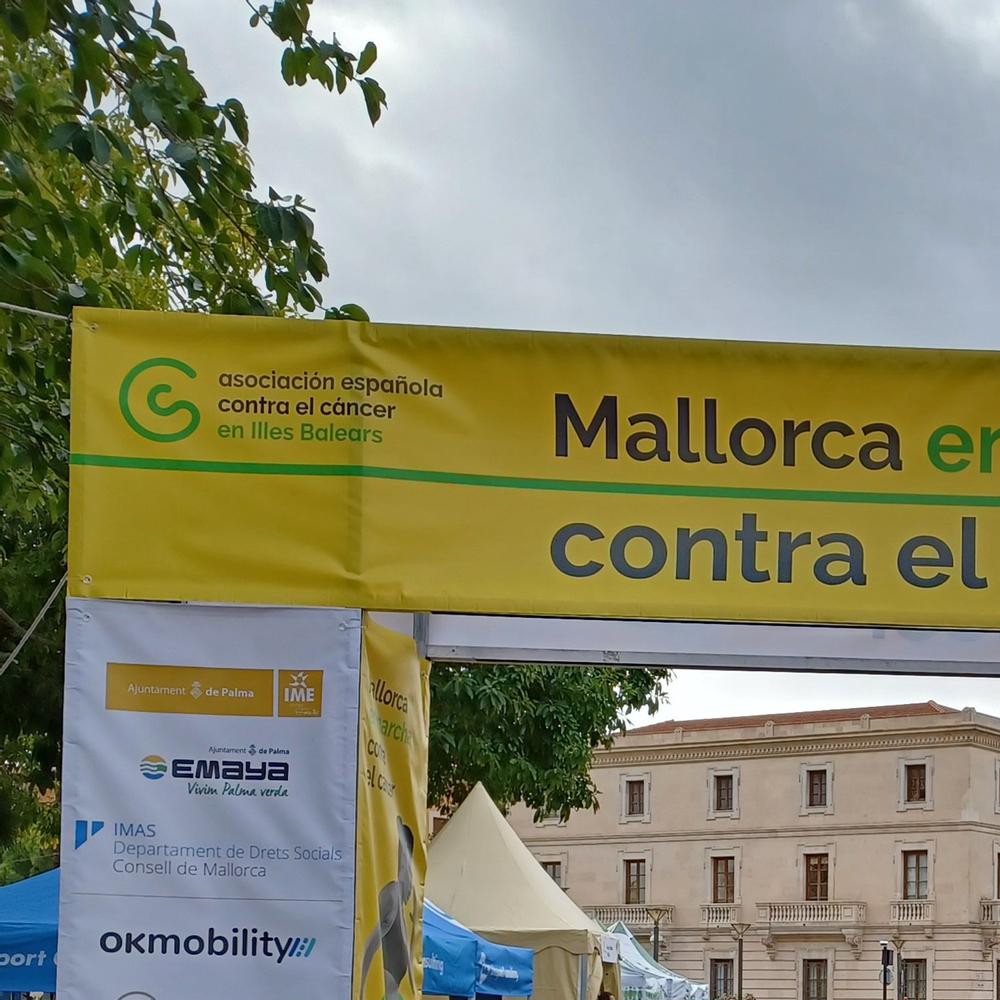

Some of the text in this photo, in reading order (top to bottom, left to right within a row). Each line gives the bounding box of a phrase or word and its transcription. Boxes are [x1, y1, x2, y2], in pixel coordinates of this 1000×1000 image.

[219, 371, 444, 400] asociación española
[217, 394, 396, 420] contra el cáncer
[217, 421, 383, 445] en Illes Balears
[553, 392, 903, 471] Mallorca
[550, 513, 867, 586] contra
[897, 516, 988, 589] el
[128, 683, 254, 698] Ajuntament de Palma
[285, 688, 314, 702] IME
[209, 746, 246, 755] Ajuntament
[188, 782, 288, 797] Vivim Palma verda
[114, 822, 156, 838] IMAS
[113, 841, 342, 861] Departament de Drets Socials
[112, 859, 266, 878] Consell de Mallorca
